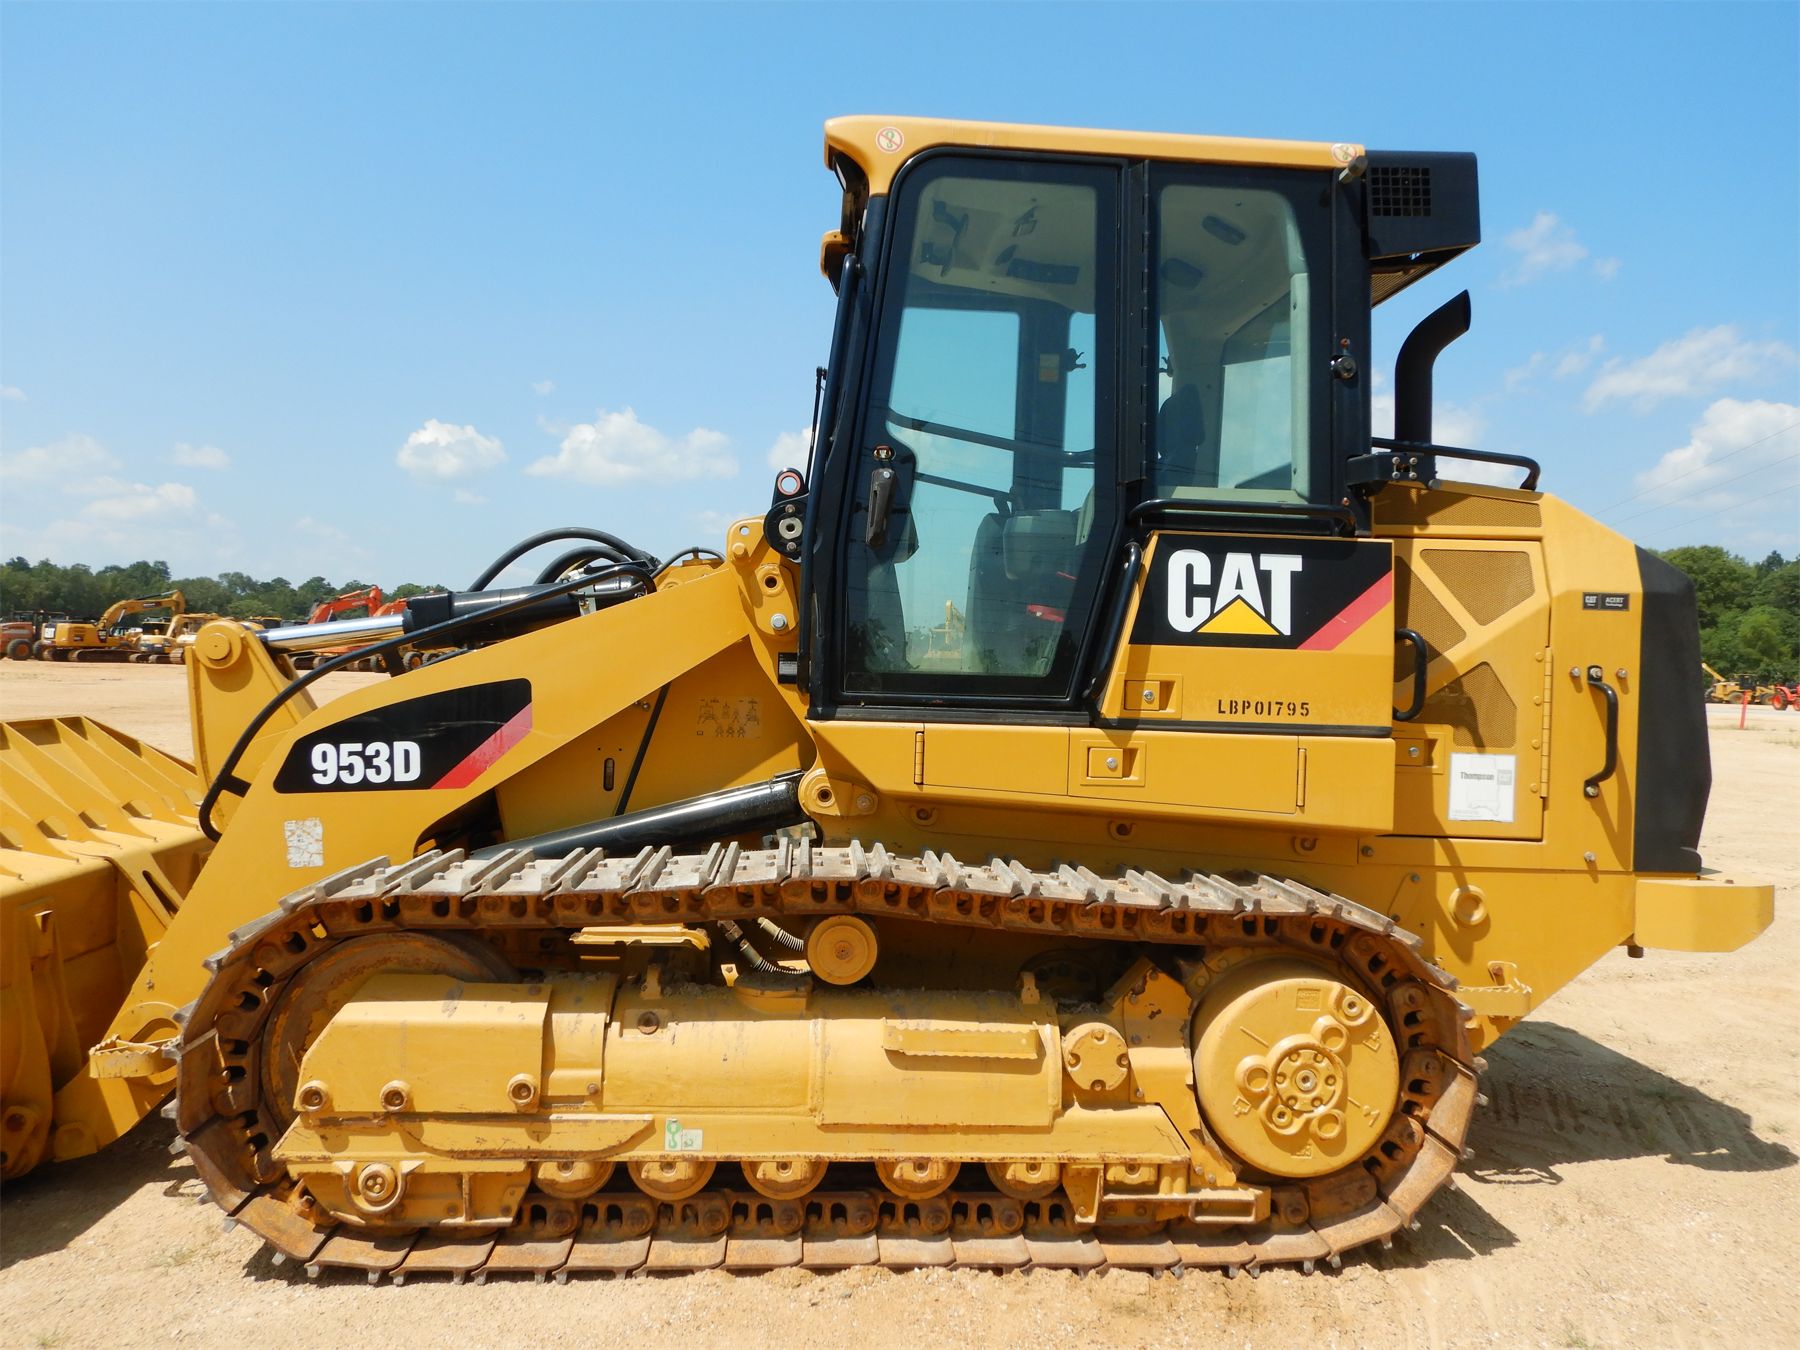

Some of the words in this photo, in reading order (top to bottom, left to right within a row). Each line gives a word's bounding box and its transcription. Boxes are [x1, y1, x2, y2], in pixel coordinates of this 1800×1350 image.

[1167, 549, 1303, 636] CAT
[1217, 699, 1310, 717] LBP01795
[311, 741, 421, 785] 953D
